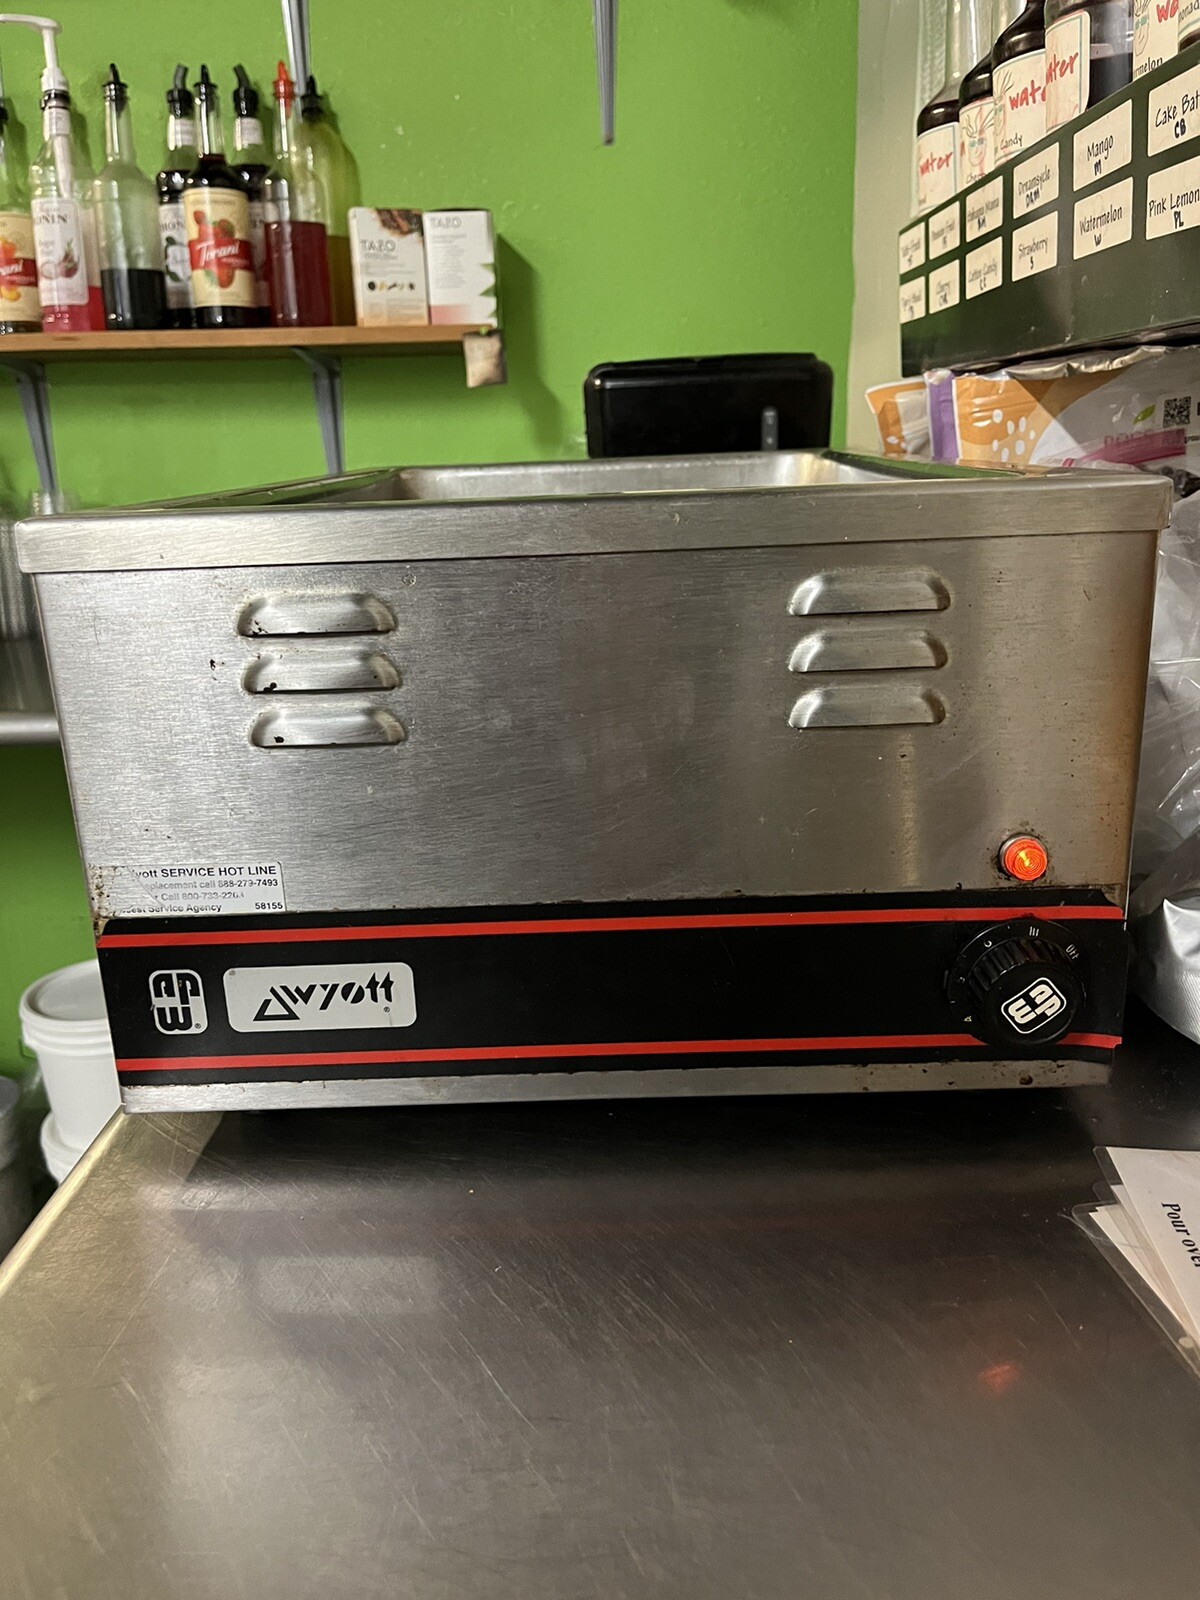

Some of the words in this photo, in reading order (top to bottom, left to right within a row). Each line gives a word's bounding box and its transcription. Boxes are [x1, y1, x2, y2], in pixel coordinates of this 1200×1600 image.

[1155, 105, 1178, 128] Cake
[1174, 118, 1187, 138] CB
[1087, 135, 1114, 161] Mango
[1149, 197, 1167, 217] Pink
[1079, 204, 1123, 236] Watermelon
[1173, 210, 1185, 230] PL
[196, 240, 240, 267] Torani
[360, 239, 397, 253] TAZO
[161, 867, 216, 878] SERVICE
[218, 866, 245, 877] HOT
[248, 865, 277, 876] LINE
[186, 903, 223, 914] Agency
[254, 902, 284, 910] 58155
[1161, 1202, 1191, 1236] Pour
